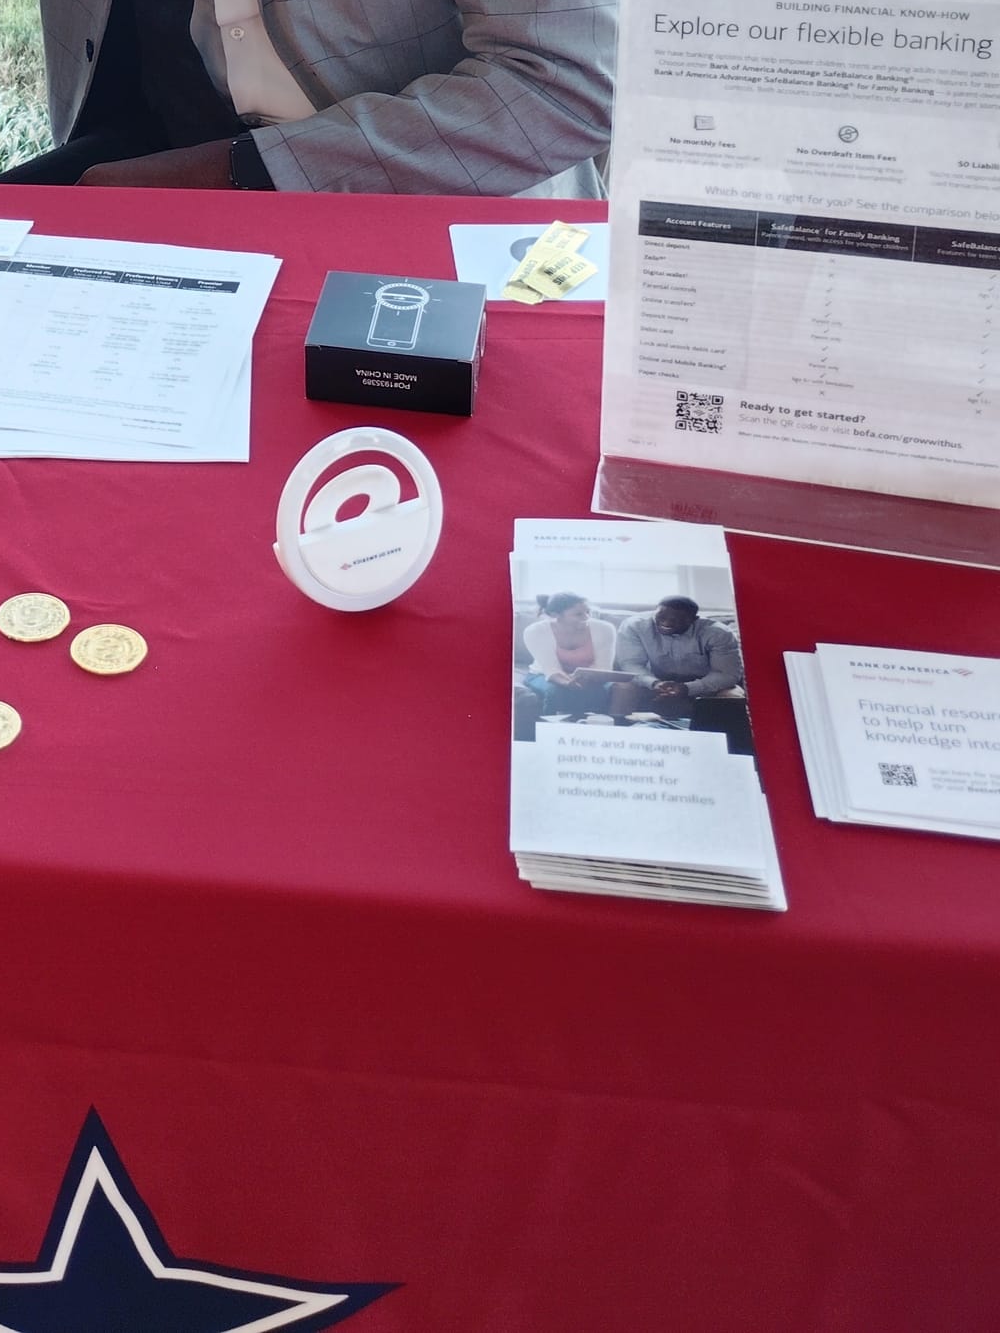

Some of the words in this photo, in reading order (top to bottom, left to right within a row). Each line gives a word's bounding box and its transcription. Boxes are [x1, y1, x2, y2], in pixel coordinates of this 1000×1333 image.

[775, 1, 831, 13] BUILDING
[834, 4, 896, 17] FINANCIAL
[900, 9, 970, 21] KNOW-HOW
[654, 13, 740, 40] Explore
[749, 24, 788, 41] our
[796, 22, 884, 47] flexible
[893, 28, 994, 60] banking
[709, 62, 729, 71] Bank
[742, 65, 775, 74] America
[777, 67, 820, 78] Advantage
[823, 70, 874, 80] SafeBalance
[654, 68, 673, 77] Bank
[675, 69, 684, 77] of
[686, 71, 718, 80] America
[720, 73, 762, 84] Advantage
[764, 76, 814, 87] SafeBalance
[857, 83, 870, 91] for
[871, 84, 899, 94] Family
[901, 87, 934, 97] Banking
[683, 139, 716, 148] monthly
[811, 149, 852, 158] Overdraft
[855, 152, 875, 160] Item
[877, 153, 896, 161] Fees
[705, 185, 738, 197] Which
[741, 191, 761, 200] one
[765, 191, 775, 201] is
[778, 193, 803, 204] right
[808, 194, 823, 205] for
[827, 197, 853, 208] you?
[856, 199, 878, 210] See
[881, 201, 899, 212] the
[903, 205, 971, 218] comparison
[665, 217, 696, 226] Account
[698, 220, 731, 229] Features
[824, 228, 837, 236] for
[839, 230, 865, 240] Family
[867, 233, 900, 243] Banking
[355, 369, 381, 378] CHINA
[382, 371, 391, 379] IN
[394, 373, 418, 382] MADE
[740, 400, 775, 414] Ready
[778, 406, 791, 414] to
[794, 409, 813, 418] get
[817, 411, 866, 423] started?
[739, 414, 761, 423] Scan
[763, 417, 778, 426] the
[780, 419, 794, 427] QR
[796, 422, 818, 431] code
[832, 426, 851, 435] visit
[849, 661, 879, 669] BANK
[900, 665, 950, 675] AMERICA
[858, 699, 935, 716] Financial
[862, 716, 880, 726] to
[886, 716, 923, 732] help
[930, 721, 966, 733] turn
[557, 737, 566, 746] A
[571, 737, 596, 747] free
[601, 740, 624, 749] and
[629, 741, 691, 755] engaging
[865, 729, 961, 750] knowledge
[968, 738, 1000, 752] into
[557, 753, 586, 764] path
[592, 755, 605, 763] to
[610, 756, 665, 767] financial
[557, 770, 653, 784] empowerment
[659, 775, 679, 786] for
[558, 786, 627, 800] individuals
[632, 791, 657, 801] and
[662, 792, 715, 805] families
